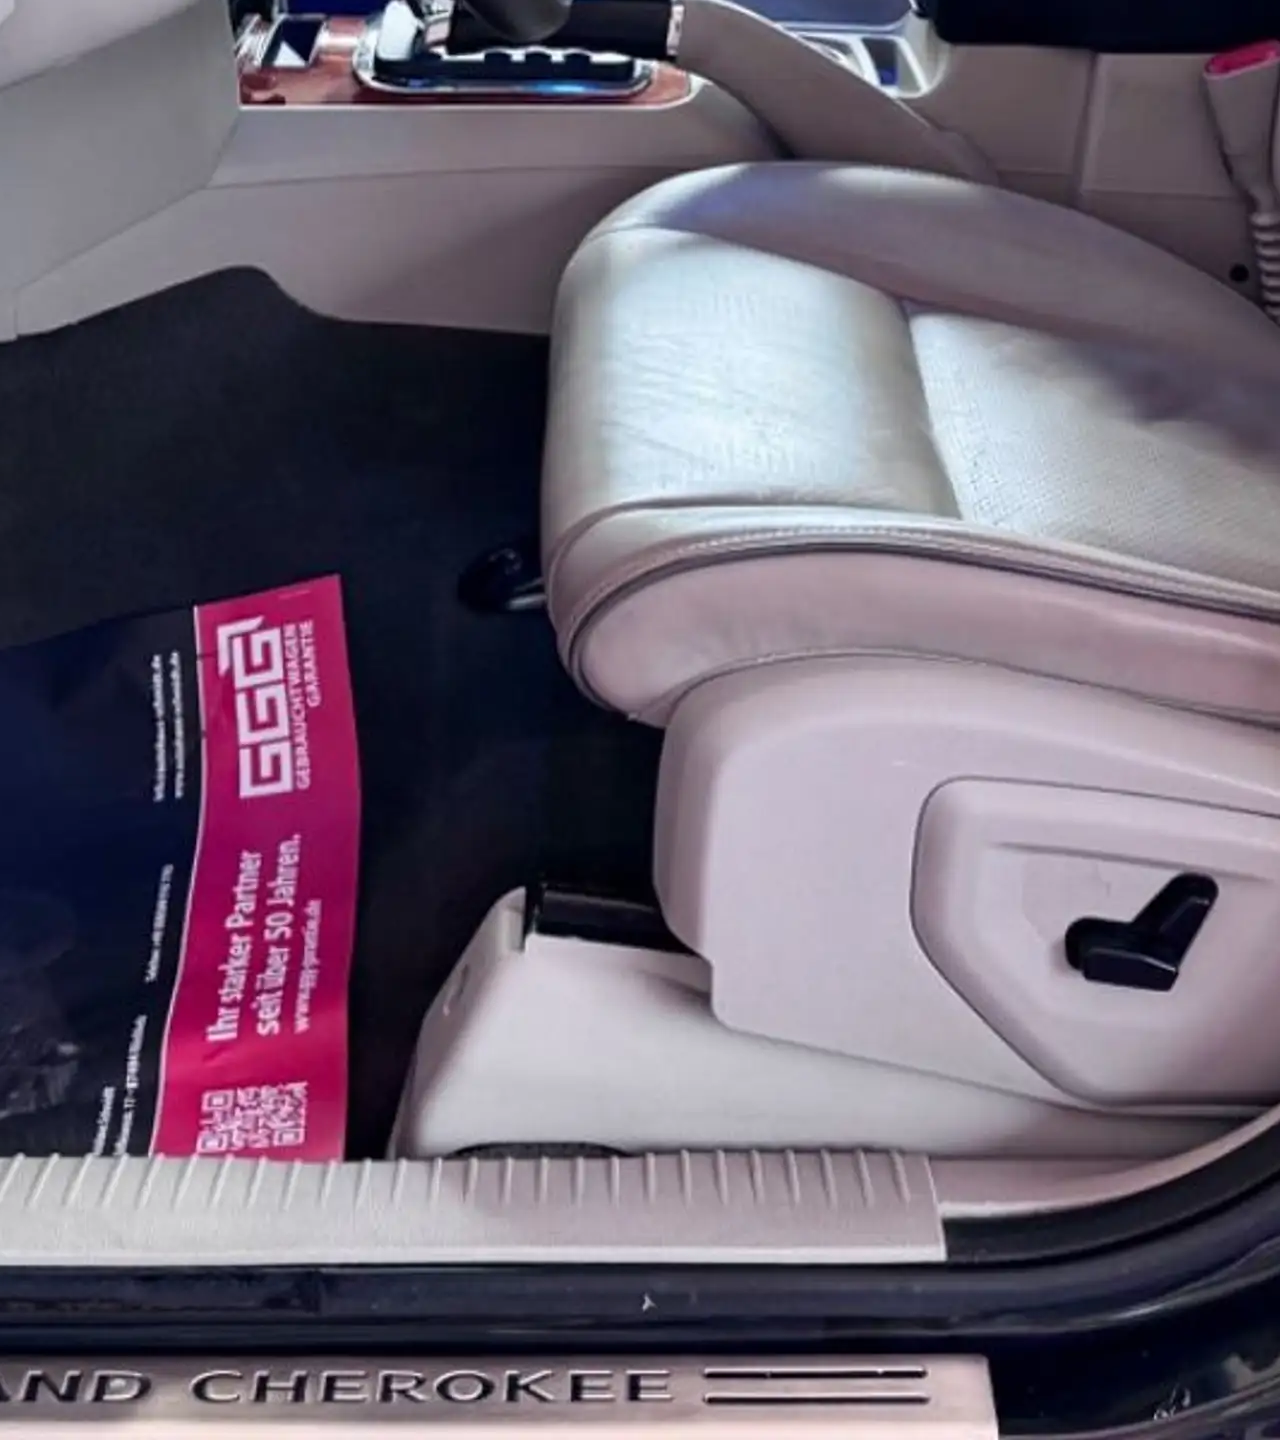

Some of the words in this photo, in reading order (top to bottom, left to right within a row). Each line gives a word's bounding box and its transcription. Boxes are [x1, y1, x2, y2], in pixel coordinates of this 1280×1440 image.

[299, 619, 322, 708] GARANTIE
[232, 626, 293, 799] GGG
[283, 623, 311, 790] GEBRAUCHTWAGEN
[225, 850, 263, 928] Partner
[267, 834, 301, 907] Jahren.
[264, 911, 294, 942] 50
[218, 934, 253, 1001] starker
[255, 946, 290, 990] über
[206, 1006, 238, 1042] Ihr
[251, 994, 283, 1037] seit
[189, 1369, 675, 1404] CHEROKEE
